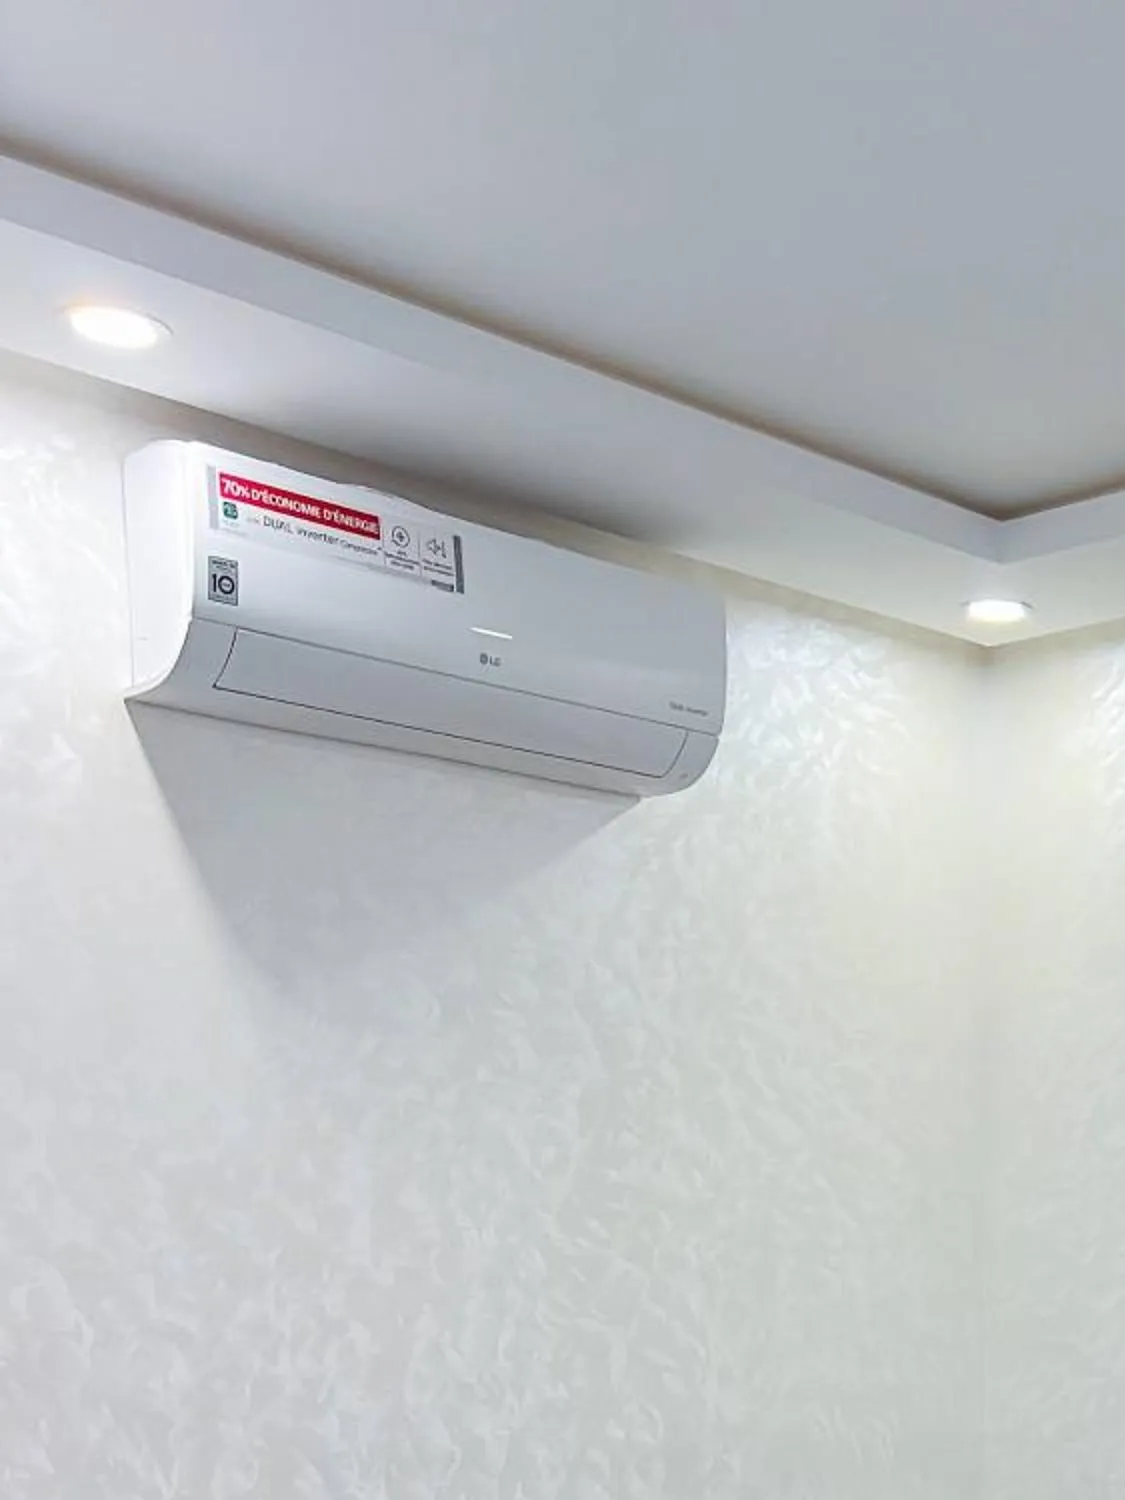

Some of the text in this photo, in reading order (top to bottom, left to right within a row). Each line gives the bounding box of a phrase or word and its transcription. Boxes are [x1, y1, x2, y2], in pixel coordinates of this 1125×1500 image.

[221, 477, 251, 499] 70%
[251, 487, 321, 519] D'ÉCONOMIE
[263, 514, 294, 535] DUAL
[211, 573, 235, 595] 10
